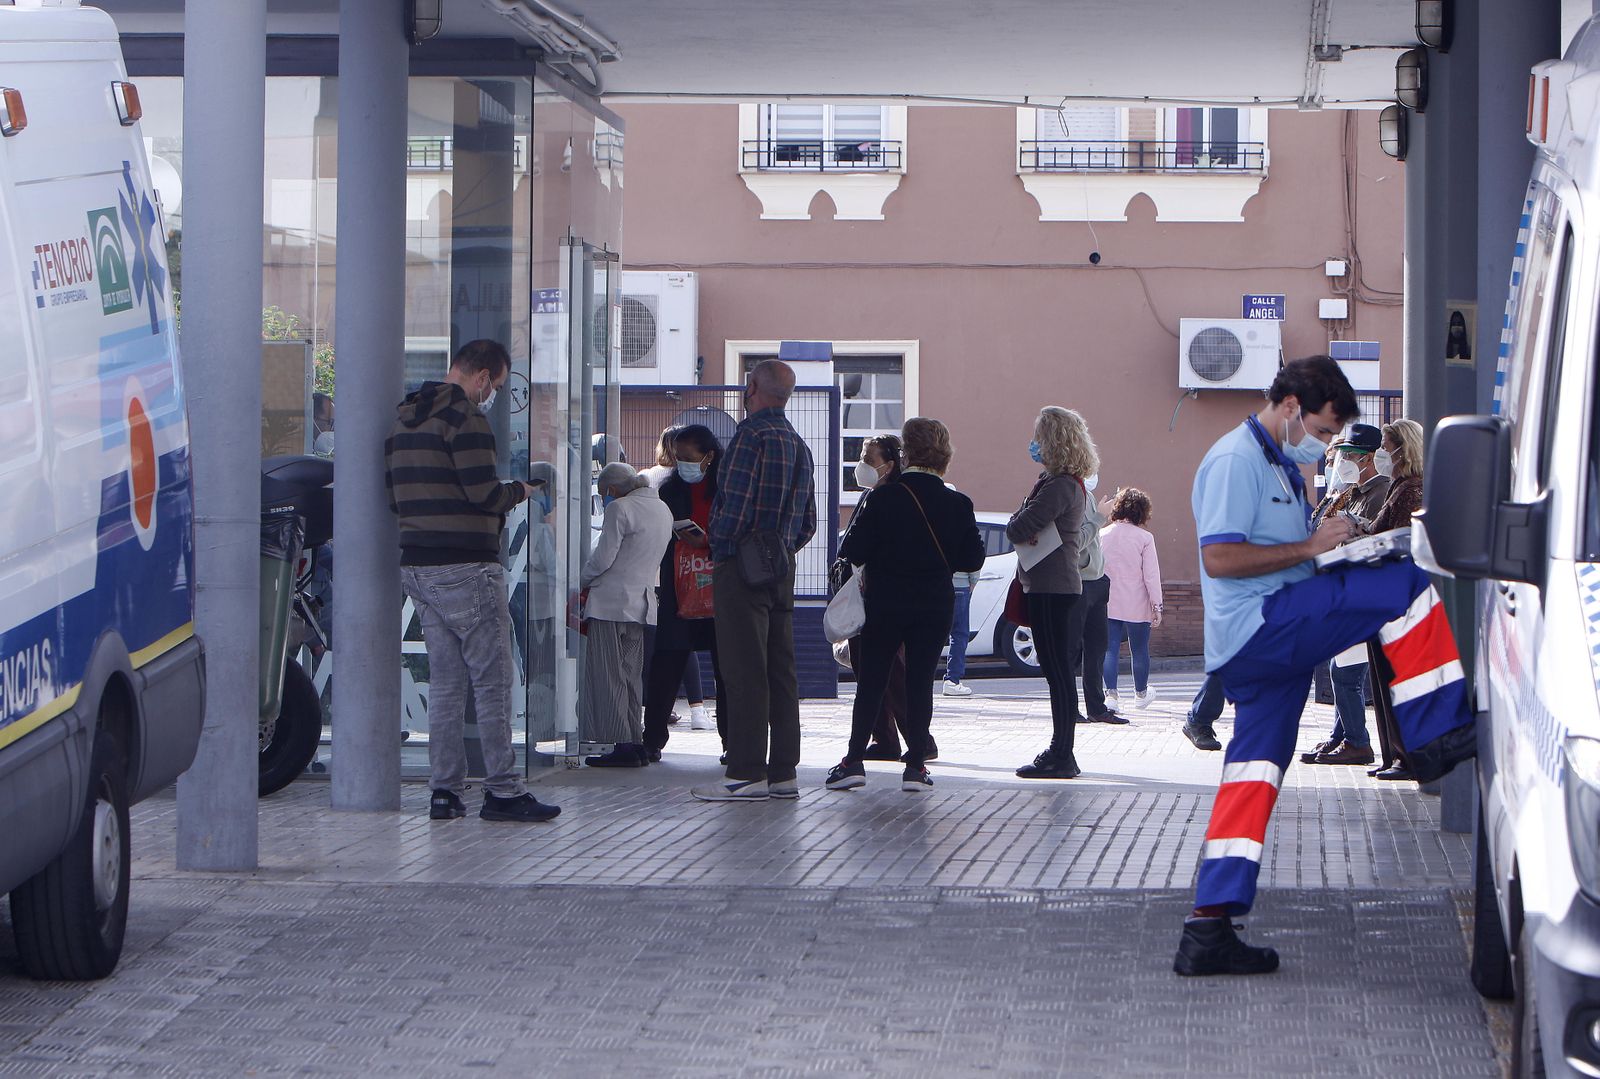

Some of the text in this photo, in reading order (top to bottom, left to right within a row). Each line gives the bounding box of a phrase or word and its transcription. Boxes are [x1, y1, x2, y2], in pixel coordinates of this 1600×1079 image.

[34, 236, 92, 290] TENORIO
[1252, 297, 1276, 305] CALLE
[1249, 308, 1278, 319] ANGEL
